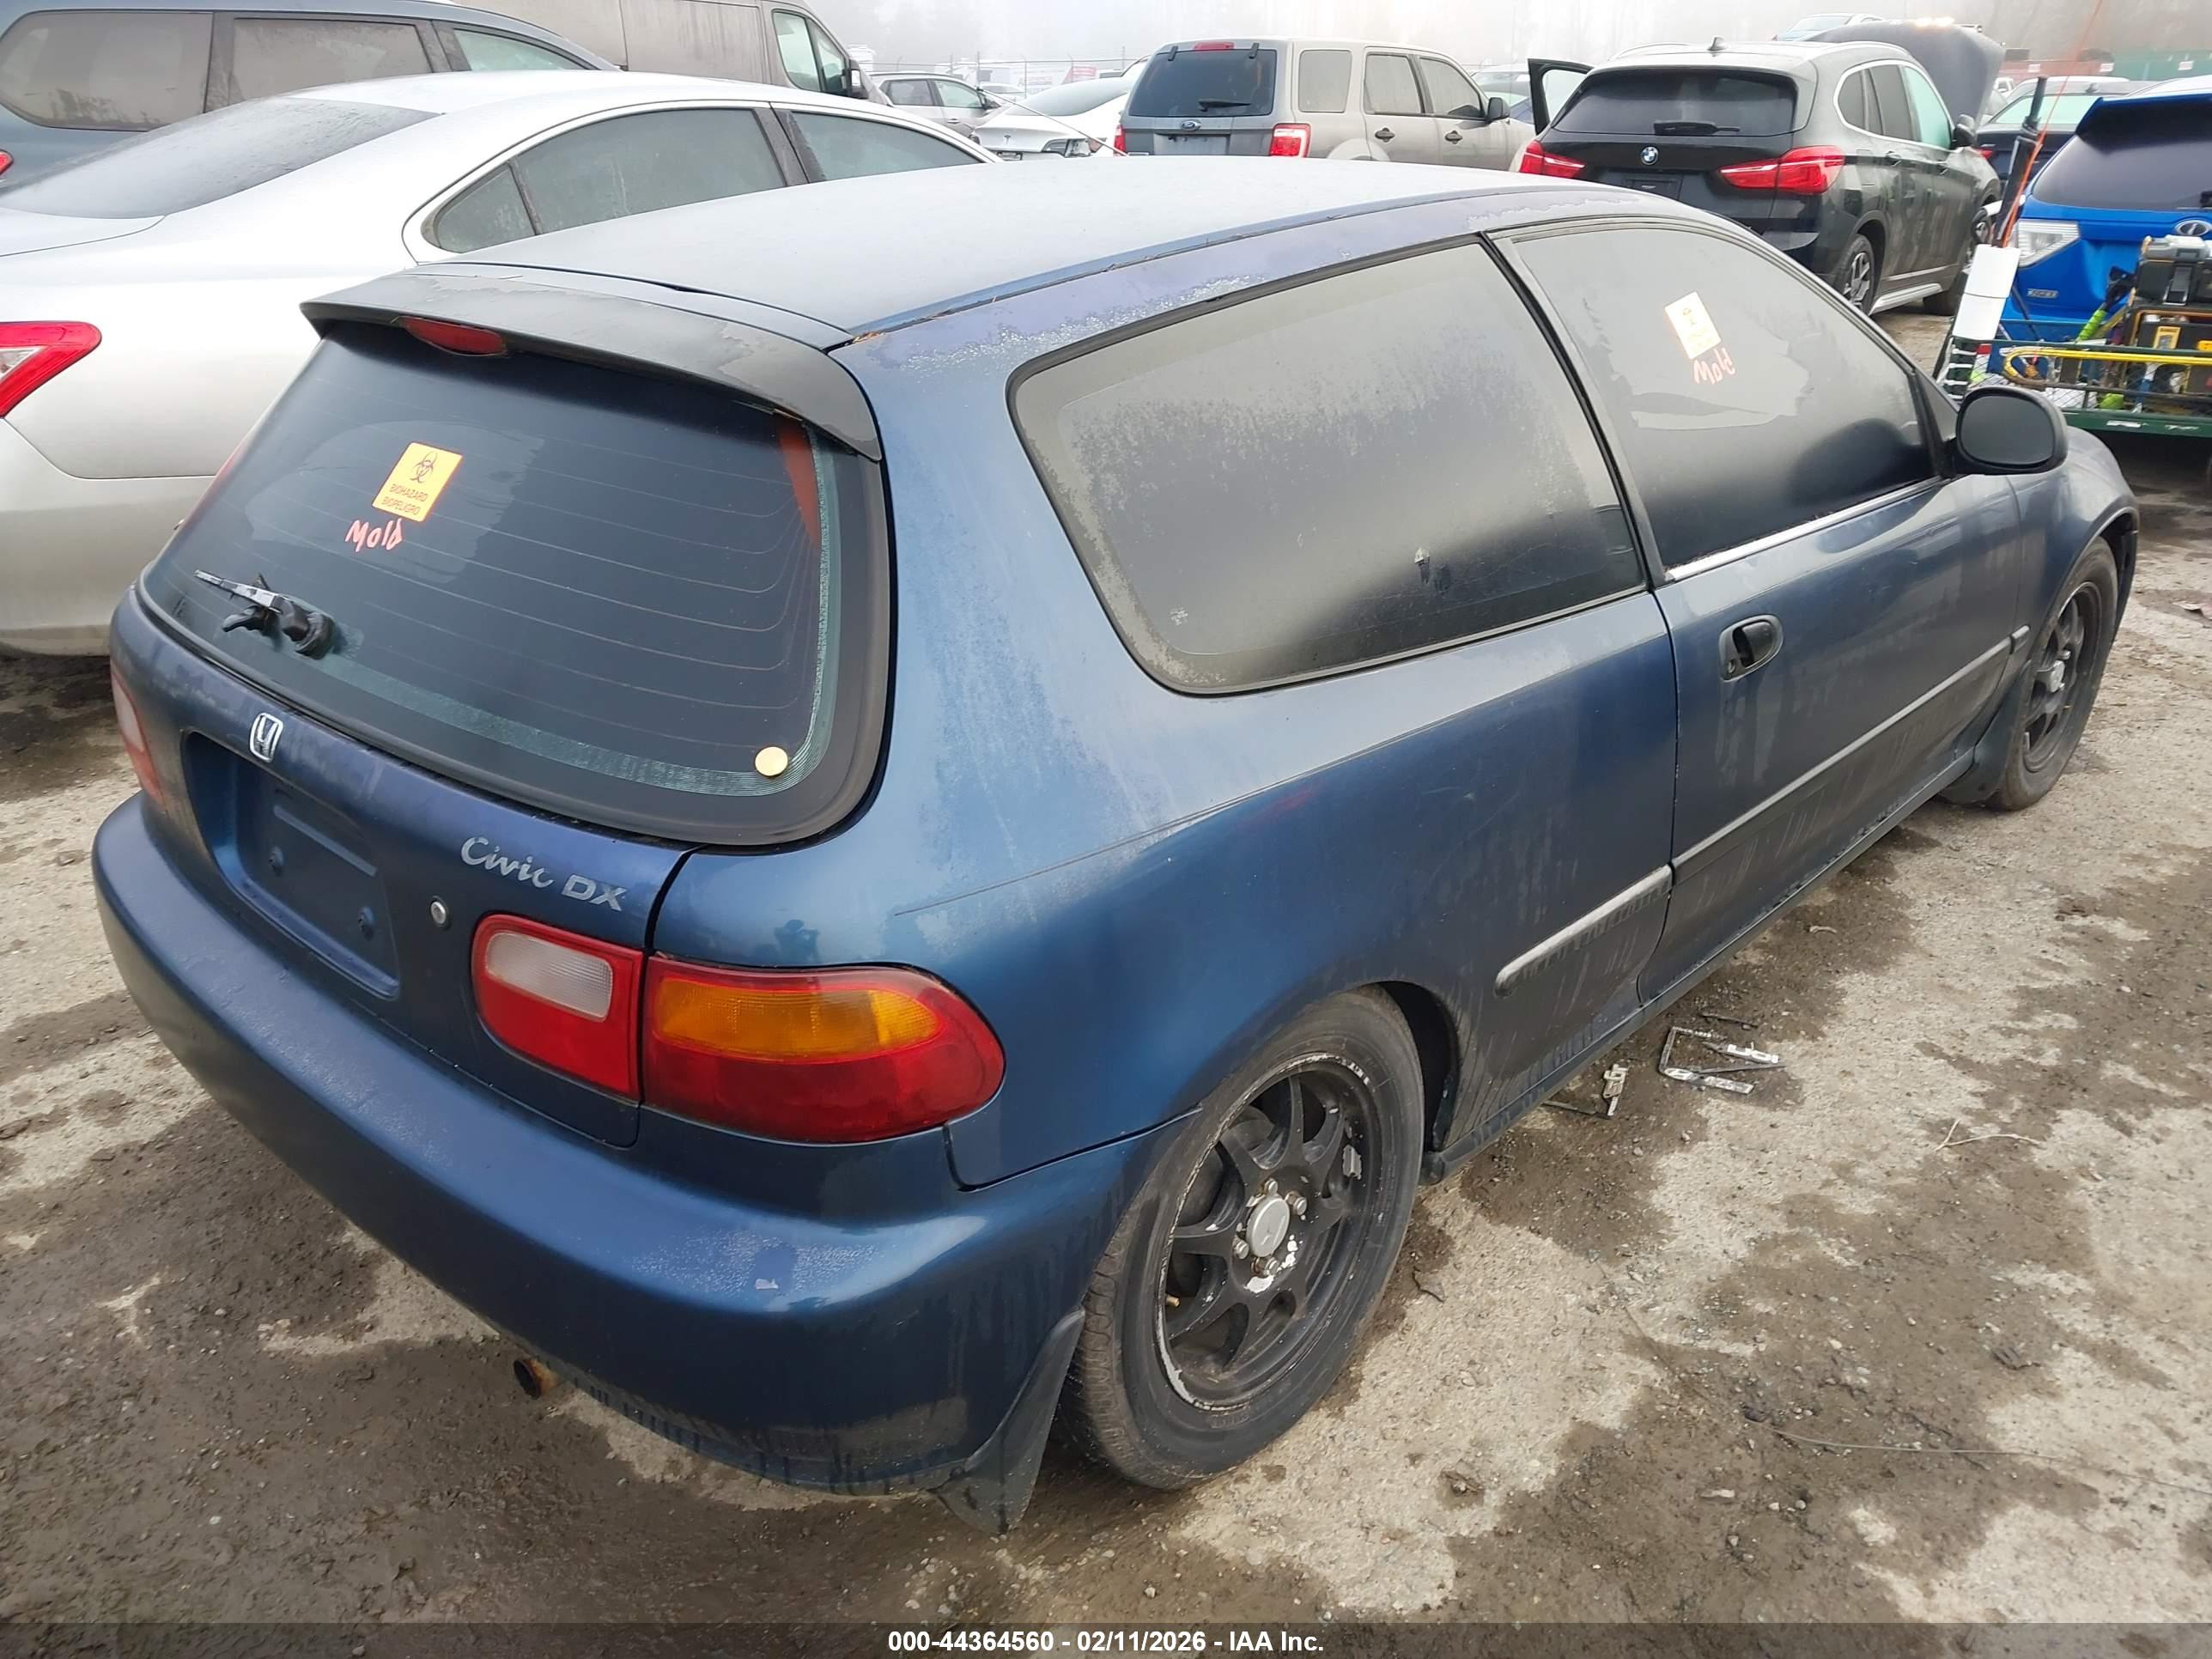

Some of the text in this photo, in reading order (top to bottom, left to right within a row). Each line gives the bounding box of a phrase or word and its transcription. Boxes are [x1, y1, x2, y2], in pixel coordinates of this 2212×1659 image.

[1692, 347, 1735, 386] Mold
[344, 517, 403, 552] Mold
[460, 836, 628, 912] Civic DX
